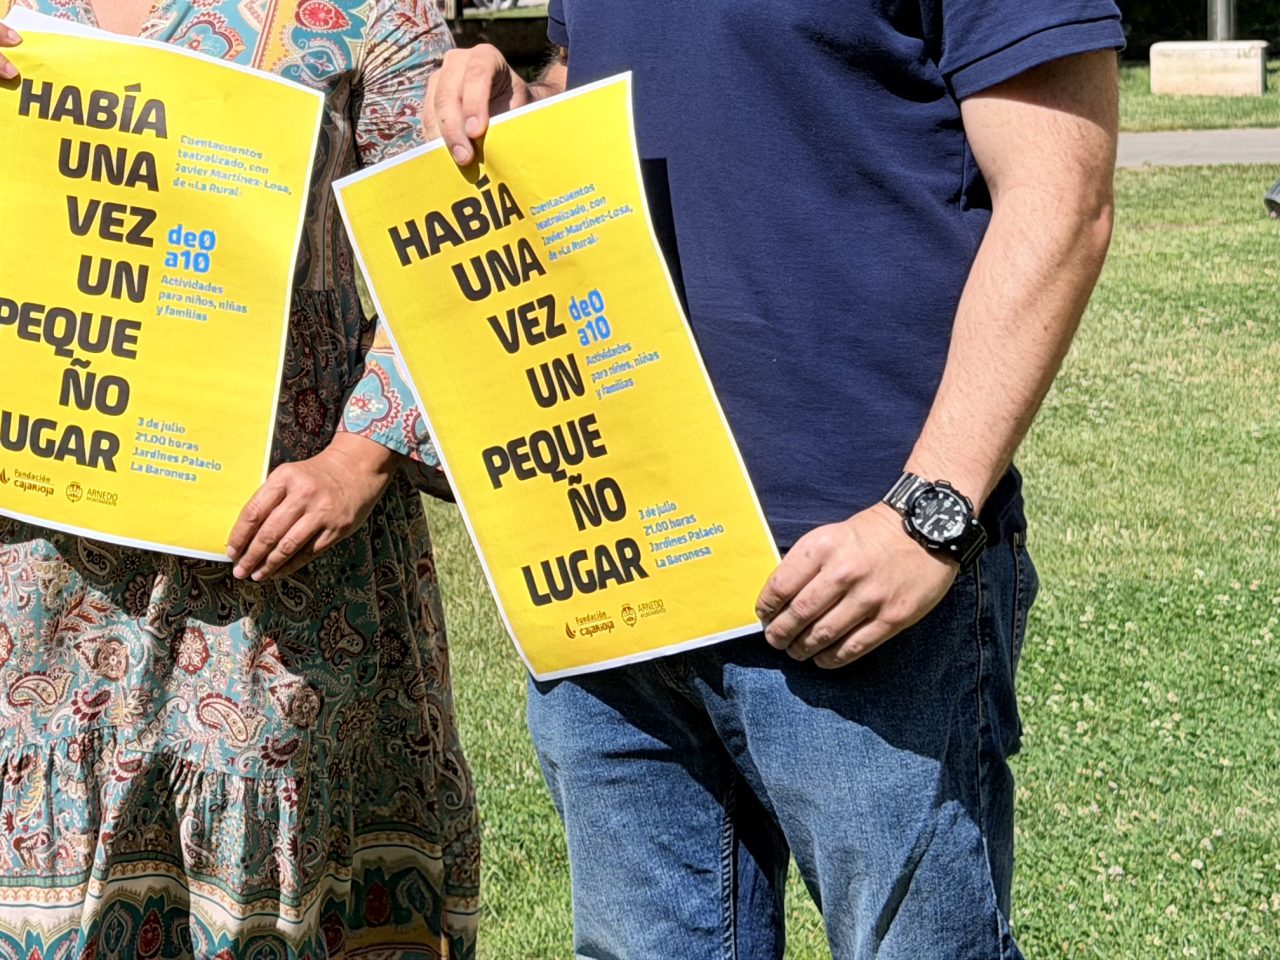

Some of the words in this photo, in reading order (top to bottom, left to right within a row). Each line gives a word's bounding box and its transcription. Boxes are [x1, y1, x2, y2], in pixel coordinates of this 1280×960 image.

[18, 77, 168, 139] HABÍA
[180, 134, 263, 159] Cuentacuentos
[58, 137, 159, 193] UNA
[175, 162, 207, 176] Javier
[249, 164, 269, 174] con
[173, 176, 186, 188] de
[590, 196, 606, 209] con
[66, 195, 157, 248] VEZ
[387, 175, 525, 268] HABÍA
[76, 254, 149, 303] UN
[451, 237, 547, 302] UNA
[161, 275, 224, 294] Actividades
[156, 306, 163, 316] y
[165, 305, 208, 321] familias
[158, 291, 183, 301] para
[185, 294, 217, 310] niños,
[219, 300, 248, 314] niñas
[487, 294, 566, 355] VEZ
[586, 343, 632, 365] Actividades
[591, 369, 608, 383] para
[634, 351, 660, 367] niñas
[58, 357, 130, 416] ÑO
[525, 352, 585, 408] UN
[601, 378, 634, 395] familias
[137, 417, 144, 426] 3
[146, 418, 159, 429] de
[160, 420, 186, 434] julio
[135, 431, 166, 445] 21.00
[168, 437, 199, 452] horas
[481, 413, 608, 490] PEQUE
[132, 447, 179, 463] Jardines
[181, 455, 222, 471] Palacio
[14, 468, 51, 483] Fundación
[130, 461, 143, 472] La
[145, 464, 197, 482] Baronesa
[86, 488, 118, 501] ARNEDO
[567, 473, 627, 532] ÑO
[646, 507, 656, 518] de
[656, 500, 677, 517] julio
[668, 514, 697, 529] horas
[649, 535, 688, 552] Jardines
[687, 523, 724, 541] Palacio
[655, 558, 666, 568] La
[666, 546, 712, 565] Baronesa
[521, 537, 649, 607] LUGAR
[638, 598, 664, 613] ARNEDO
[575, 610, 607, 624] Fundación
